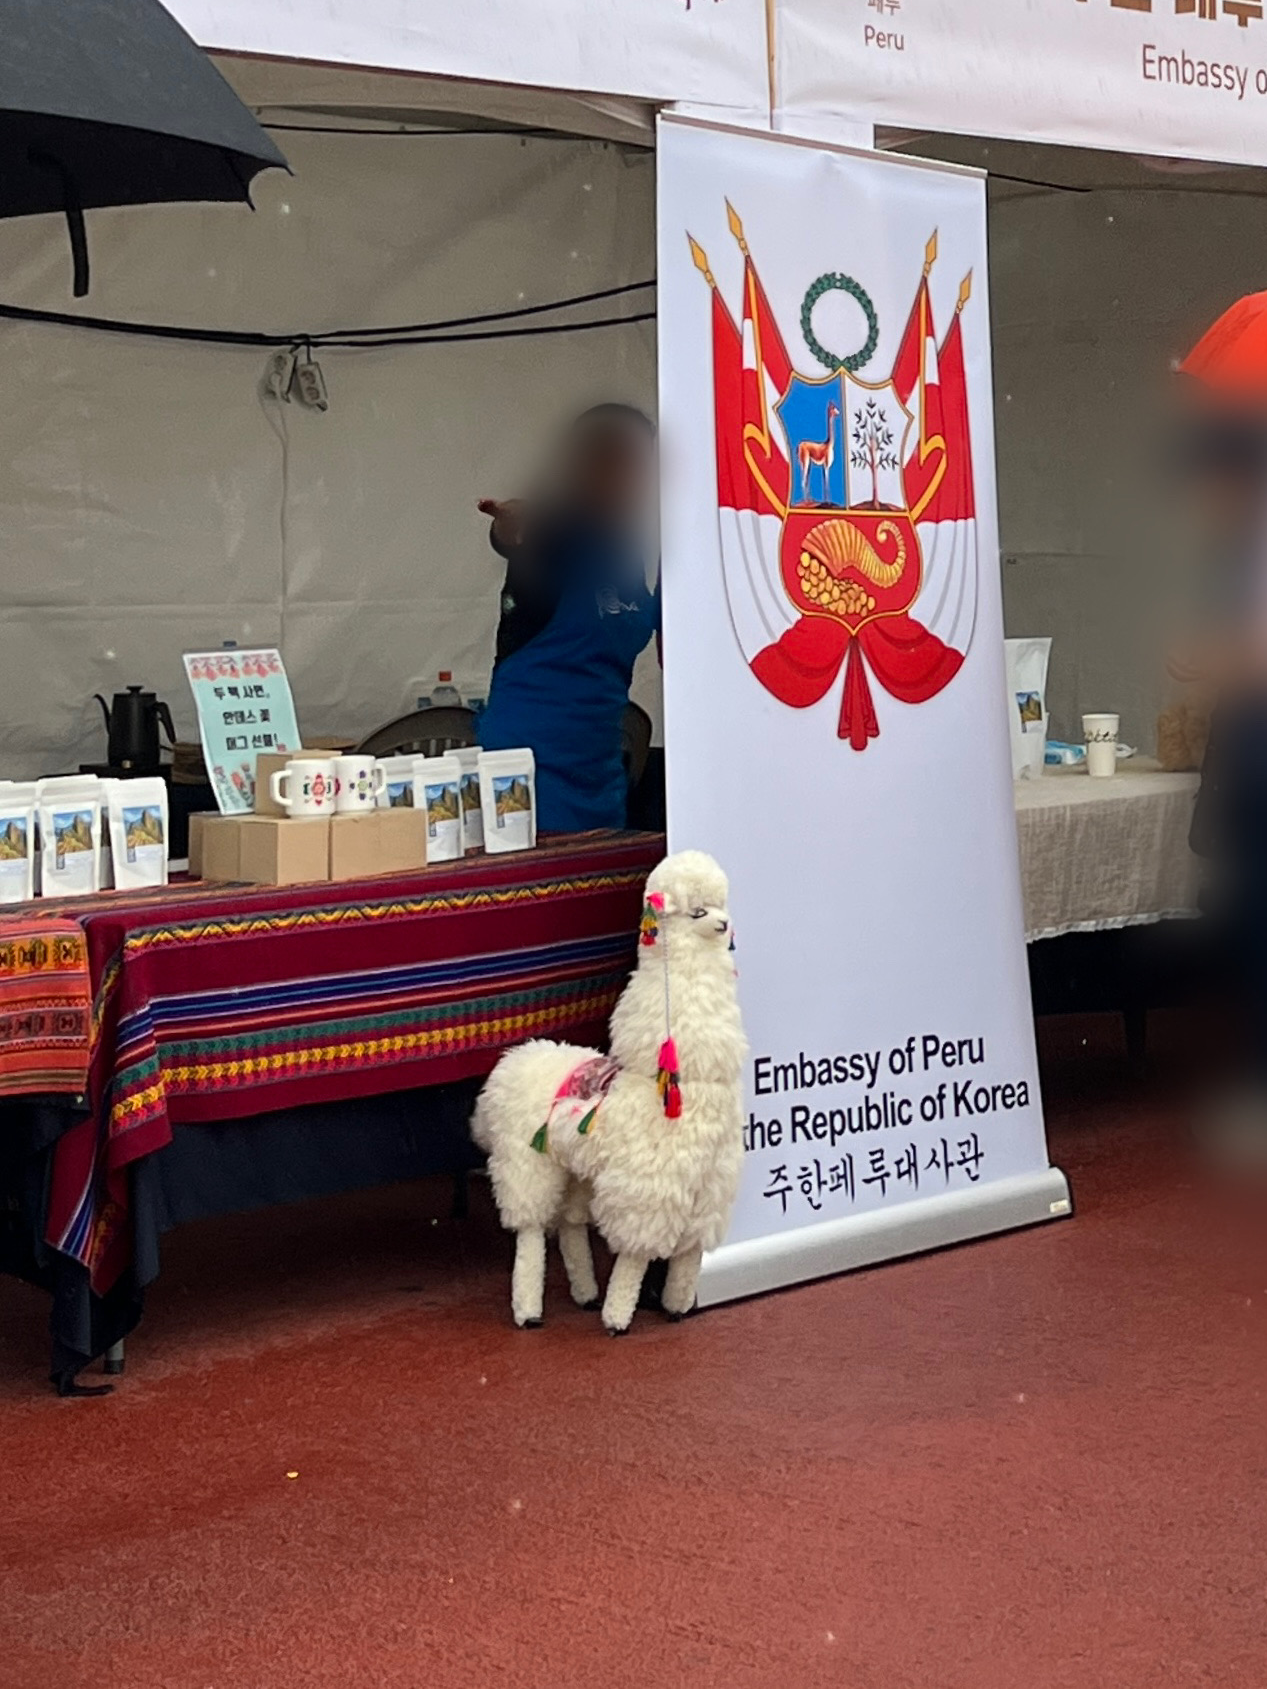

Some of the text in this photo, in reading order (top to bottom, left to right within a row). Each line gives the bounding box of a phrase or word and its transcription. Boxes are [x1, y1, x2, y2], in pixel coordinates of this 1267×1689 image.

[863, 25, 905, 51] Peru
[1142, 43, 1248, 101] Embassy
[213, 686, 226, 701] 두
[222, 709, 257, 726] 안데스
[753, 1034, 985, 1096] Embassy of Peru
[790, 1092, 913, 1147] Republic
[919, 1086, 946, 1122] of
[953, 1078, 1031, 1118] Korea
[762, 1131, 985, 1216] 주한페루대사관
